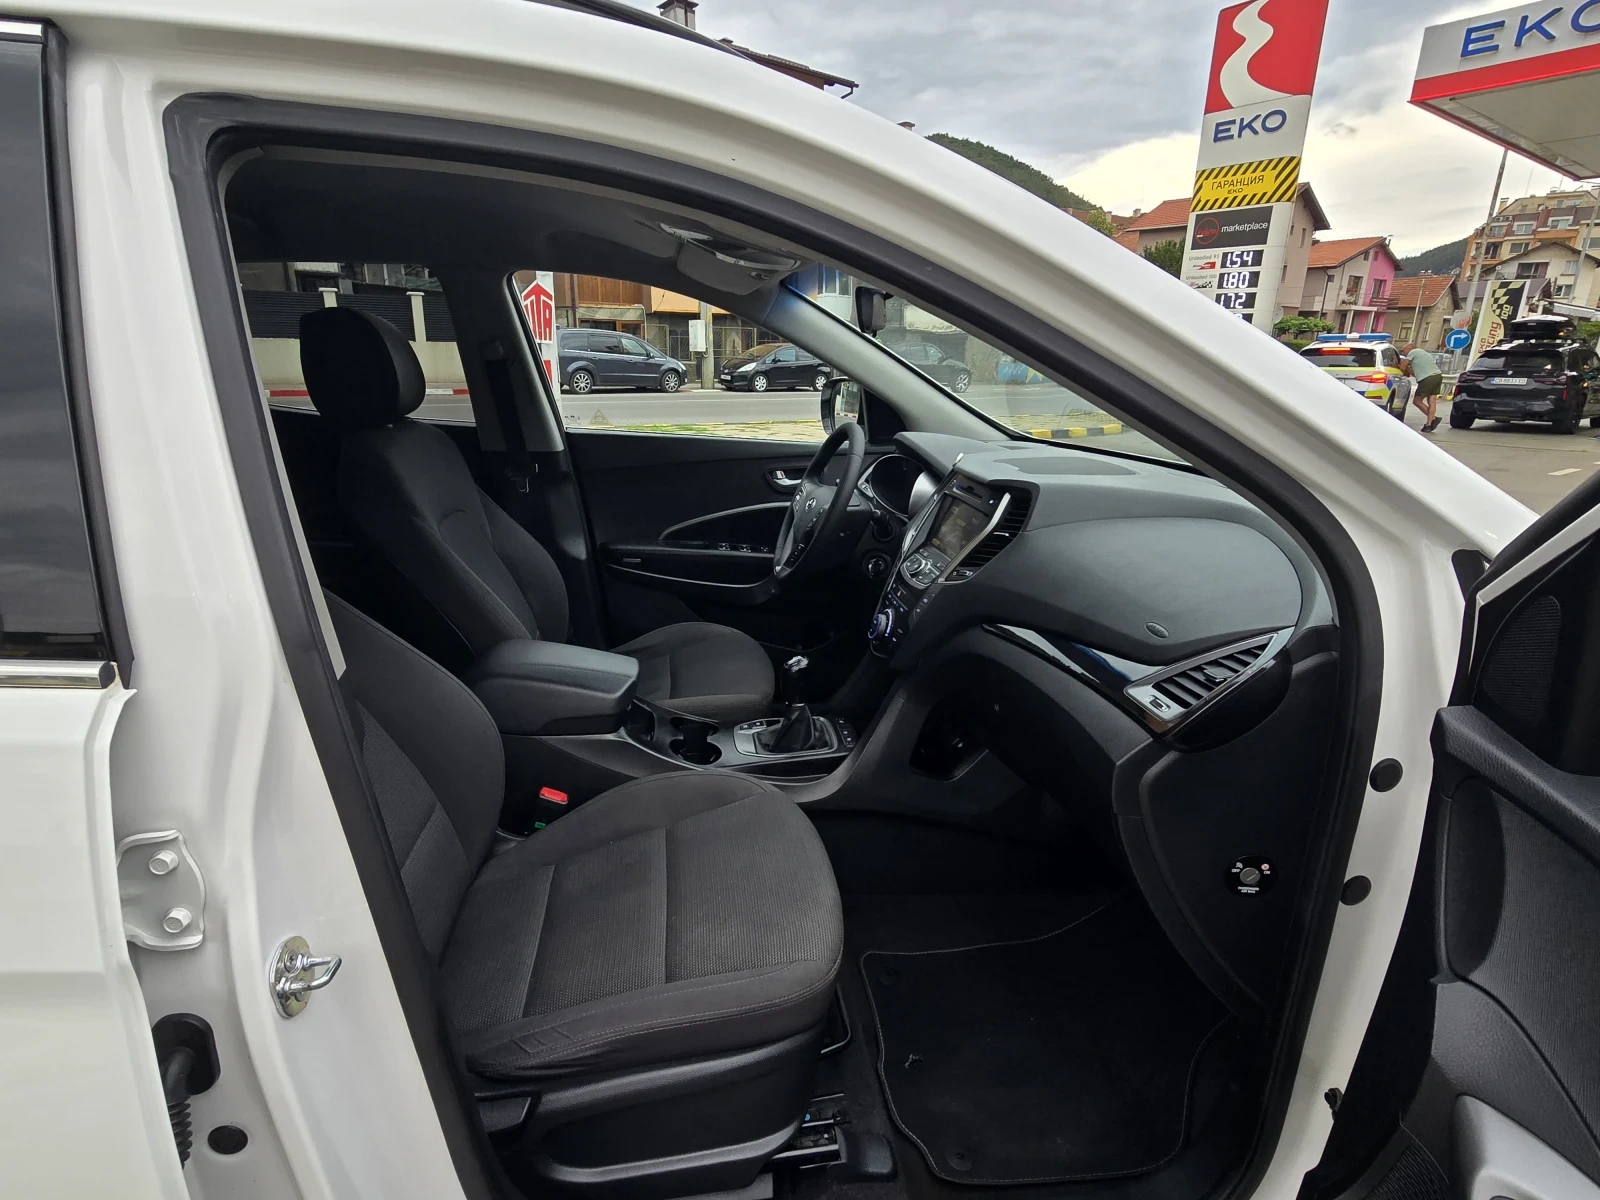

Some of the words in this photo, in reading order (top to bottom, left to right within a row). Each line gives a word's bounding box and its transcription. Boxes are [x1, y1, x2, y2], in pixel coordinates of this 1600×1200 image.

[1460, 0, 1600, 58] EKO
[1213, 109, 1287, 143] EKO
[1211, 174, 1265, 191] ГАРАНЦИЯ
[1221, 221, 1268, 233] marketplace
[1501, 304, 1510, 320] 100
[1485, 321, 1502, 350] acing
